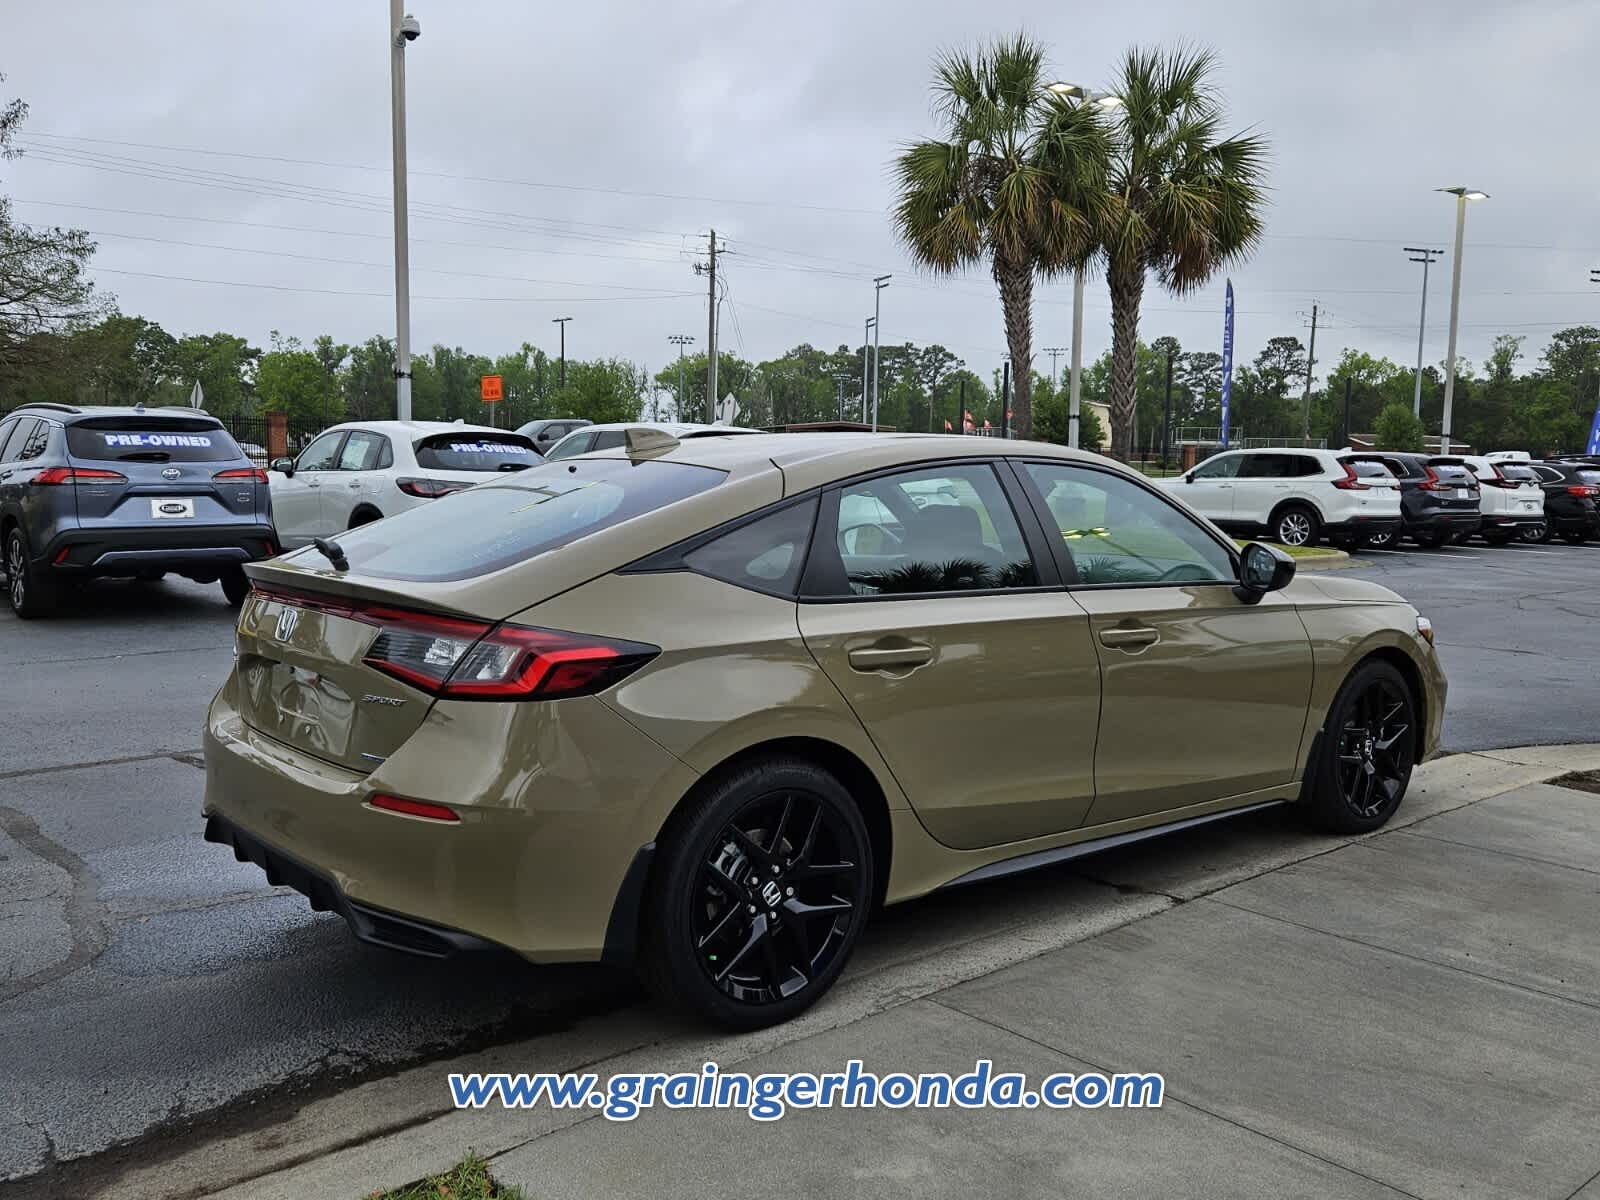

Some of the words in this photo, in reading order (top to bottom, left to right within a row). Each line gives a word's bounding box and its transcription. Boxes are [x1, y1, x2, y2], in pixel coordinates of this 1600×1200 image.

[104, 434, 212, 447] PRE-OWNED
[450, 443, 527, 454] PRE-OWNED
[361, 694, 408, 706] SPORT
